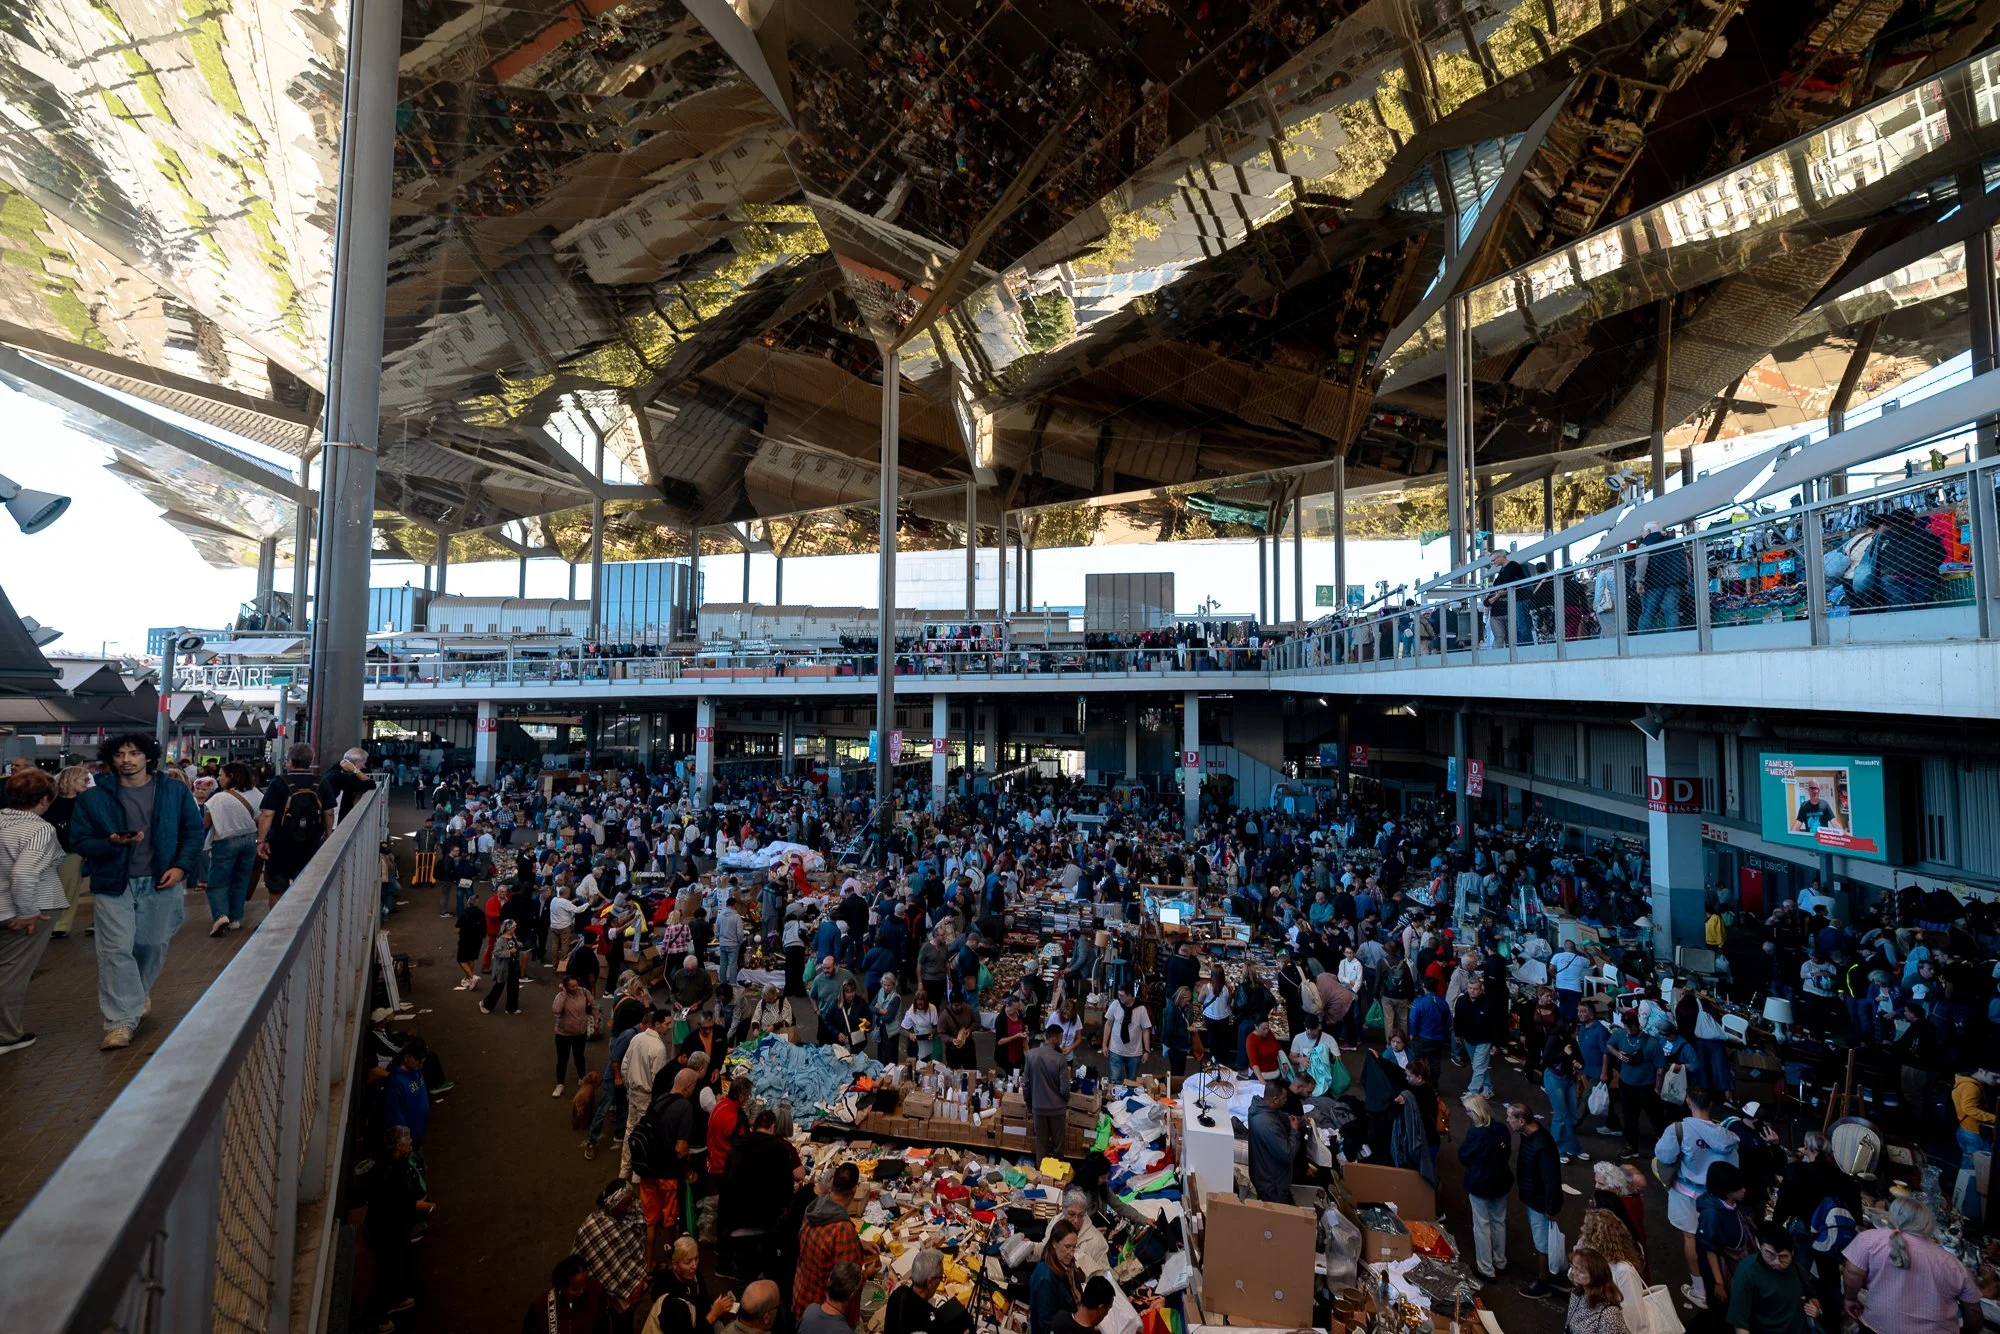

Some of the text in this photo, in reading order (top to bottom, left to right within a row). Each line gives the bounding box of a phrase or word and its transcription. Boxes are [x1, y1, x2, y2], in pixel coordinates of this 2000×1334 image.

[479, 719, 487, 728] D
[699, 727, 707, 738] D
[893, 733, 899, 744] D
[935, 739, 943, 749] D
[1355, 745, 1363, 754] D
[1187, 752, 1197, 763] D
[1472, 762, 1478, 774] D
[1769, 767, 1796, 777] MERCAT
[1650, 777, 1663, 801] D
[1673, 779, 1694, 803] D
